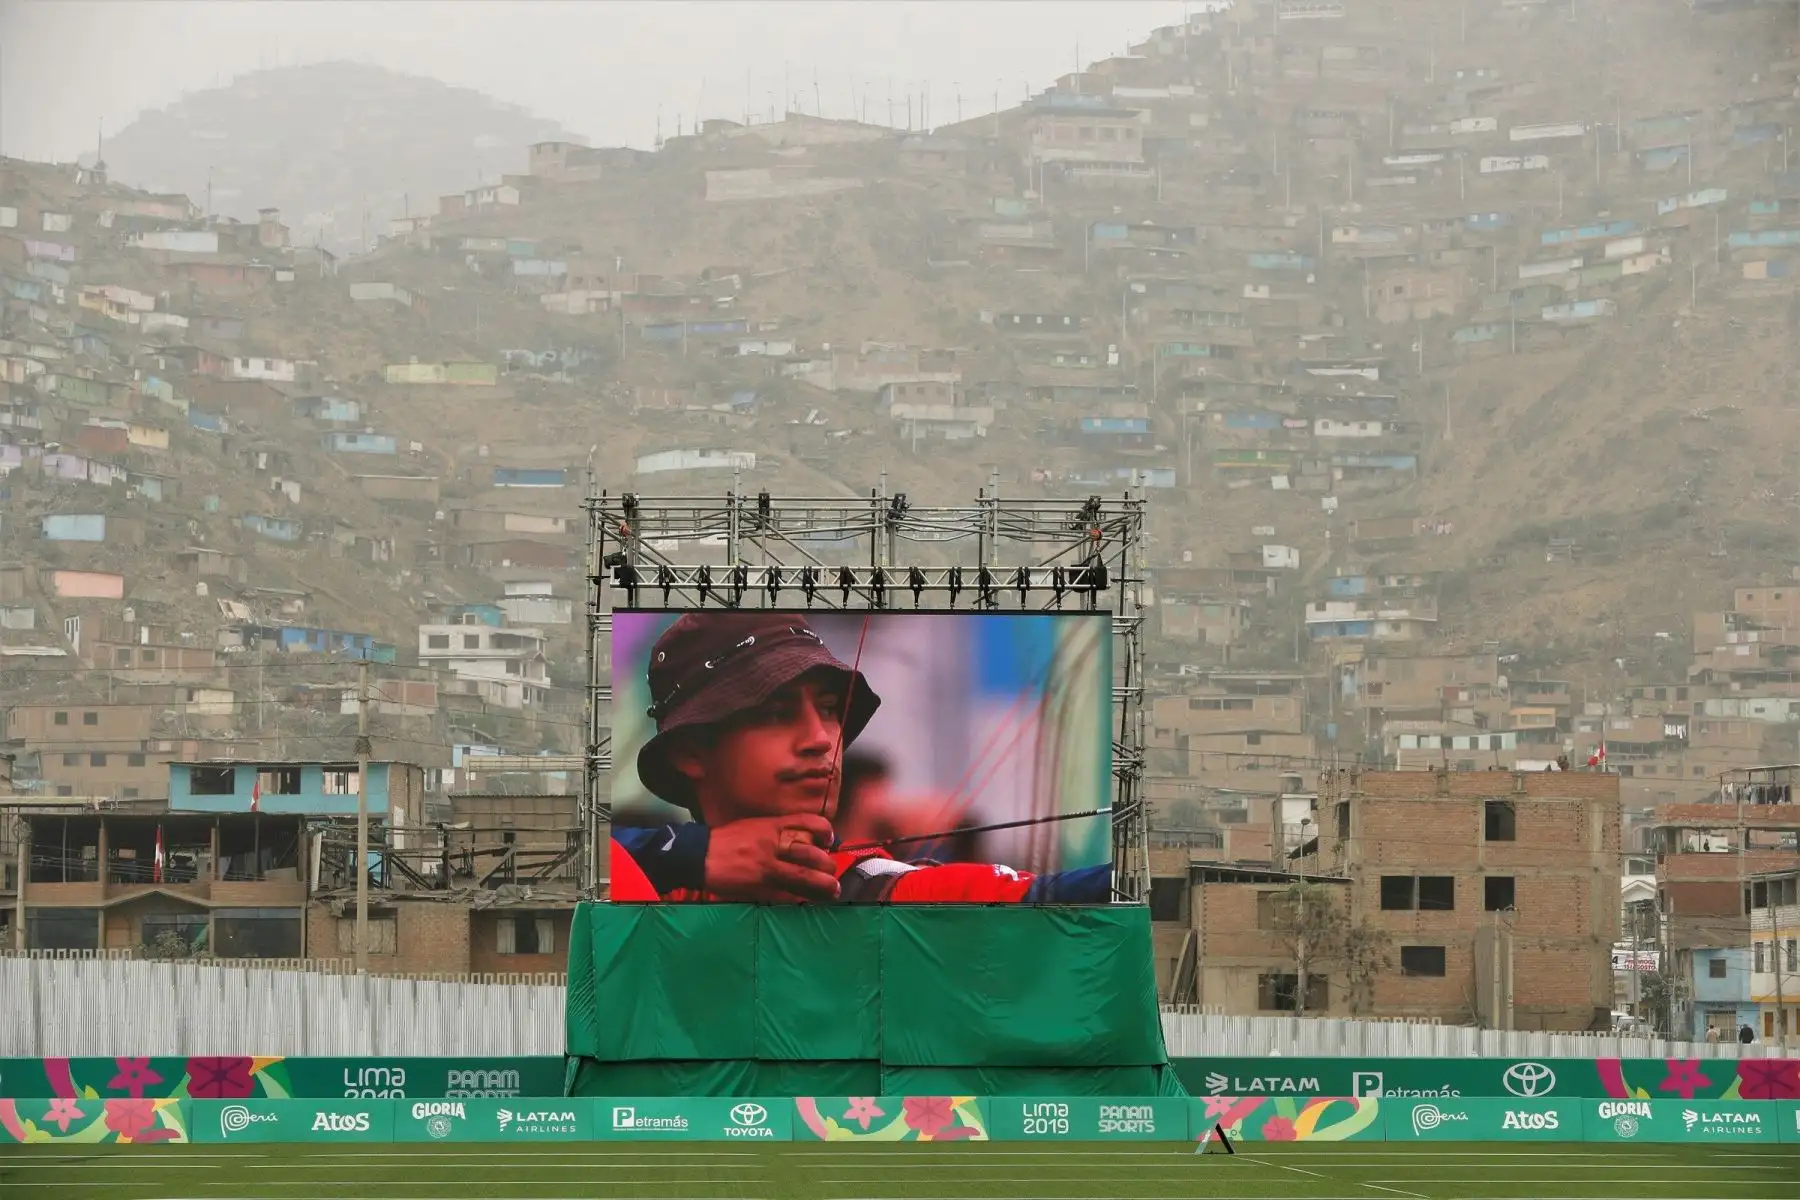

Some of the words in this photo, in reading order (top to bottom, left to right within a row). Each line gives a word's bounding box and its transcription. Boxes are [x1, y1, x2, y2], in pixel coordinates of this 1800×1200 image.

[447, 1069, 520, 1089] PANAM
[1234, 1076, 1320, 1092] LATAM
[411, 1102, 466, 1120] GLORIA
[516, 1111, 576, 1122] LATAM
[612, 1107, 689, 1128] Petramás
[1099, 1105, 1153, 1119] PANAM
[1598, 1101, 1652, 1120] GLORIA
[1702, 1112, 1761, 1123] LATAM
[516, 1125, 576, 1133] AIRLINES
[723, 1127, 773, 1137] TOYOTA
[1023, 1118, 1069, 1134] 2019
[1098, 1119, 1155, 1133] SPORTS
[1703, 1126, 1762, 1134] AIRLINES
